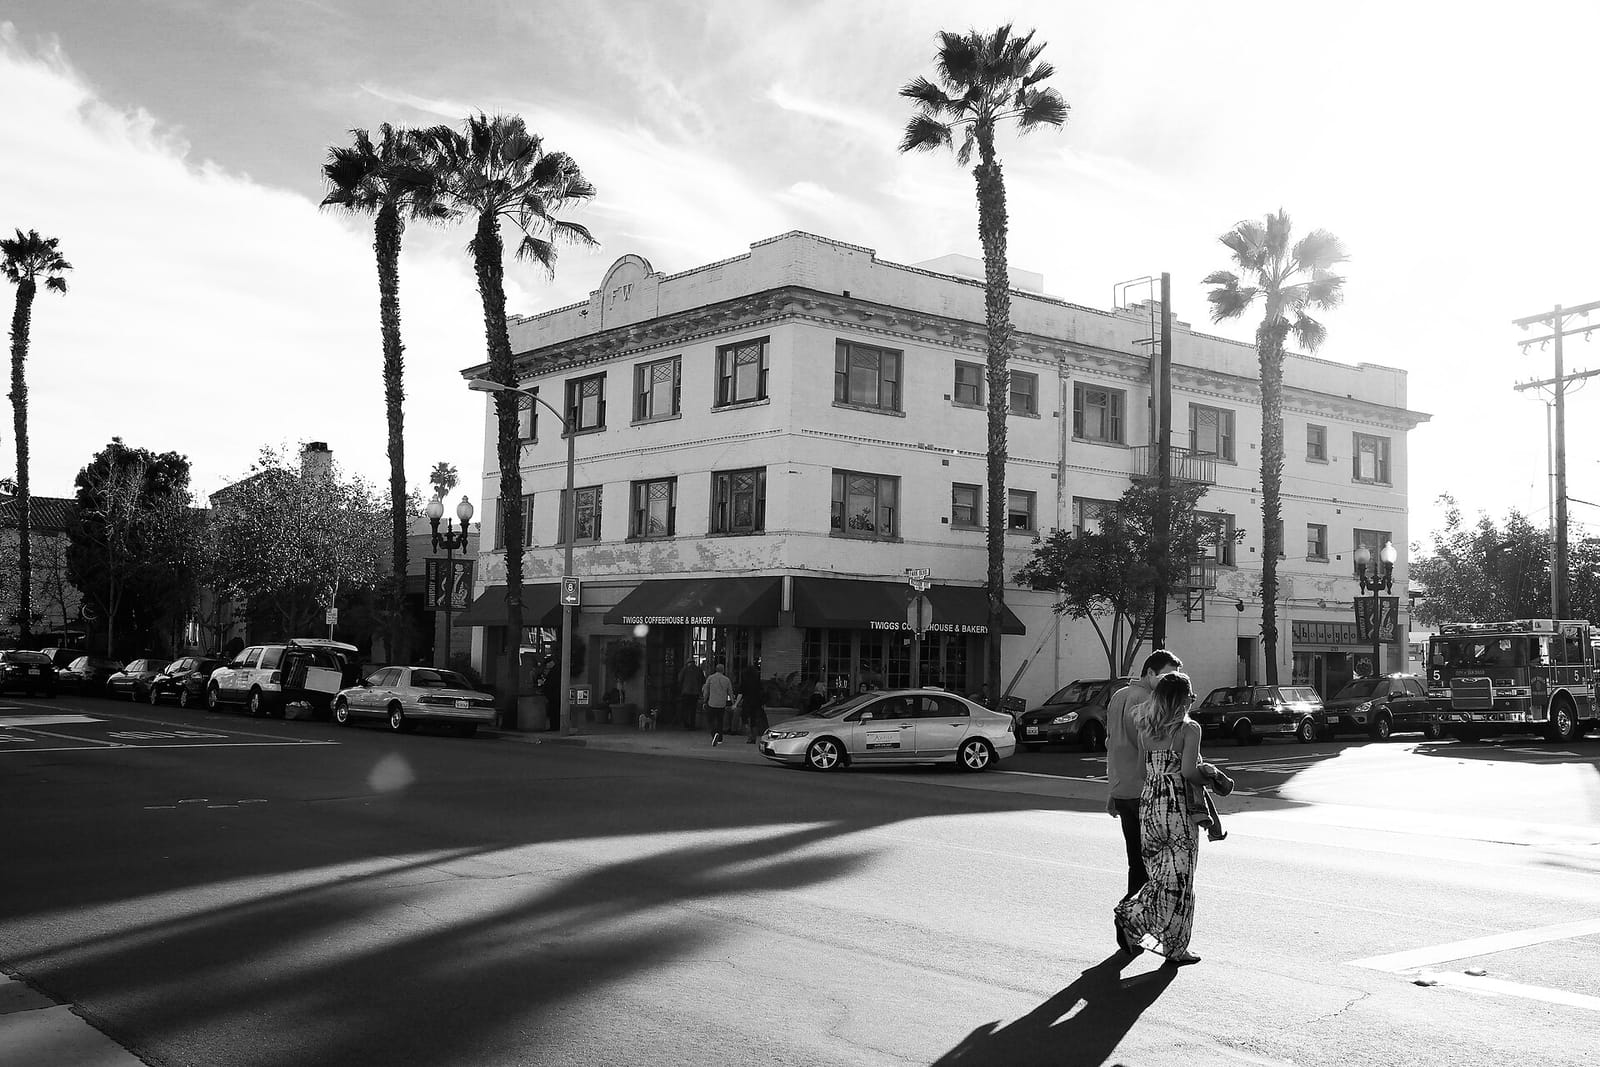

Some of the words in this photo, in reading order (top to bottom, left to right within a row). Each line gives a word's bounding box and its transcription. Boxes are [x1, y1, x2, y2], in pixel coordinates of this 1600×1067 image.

[568, 583, 573, 591] 8
[622, 616, 643, 624] TWIGGS
[644, 616, 684, 624] COFFEEHOUSE
[690, 616, 715, 624] BAKERY
[870, 621, 900, 630] TWIGGS
[955, 624, 960, 632] &
[1433, 670, 1441, 680] 5
[1574, 670, 1580, 682] 5
